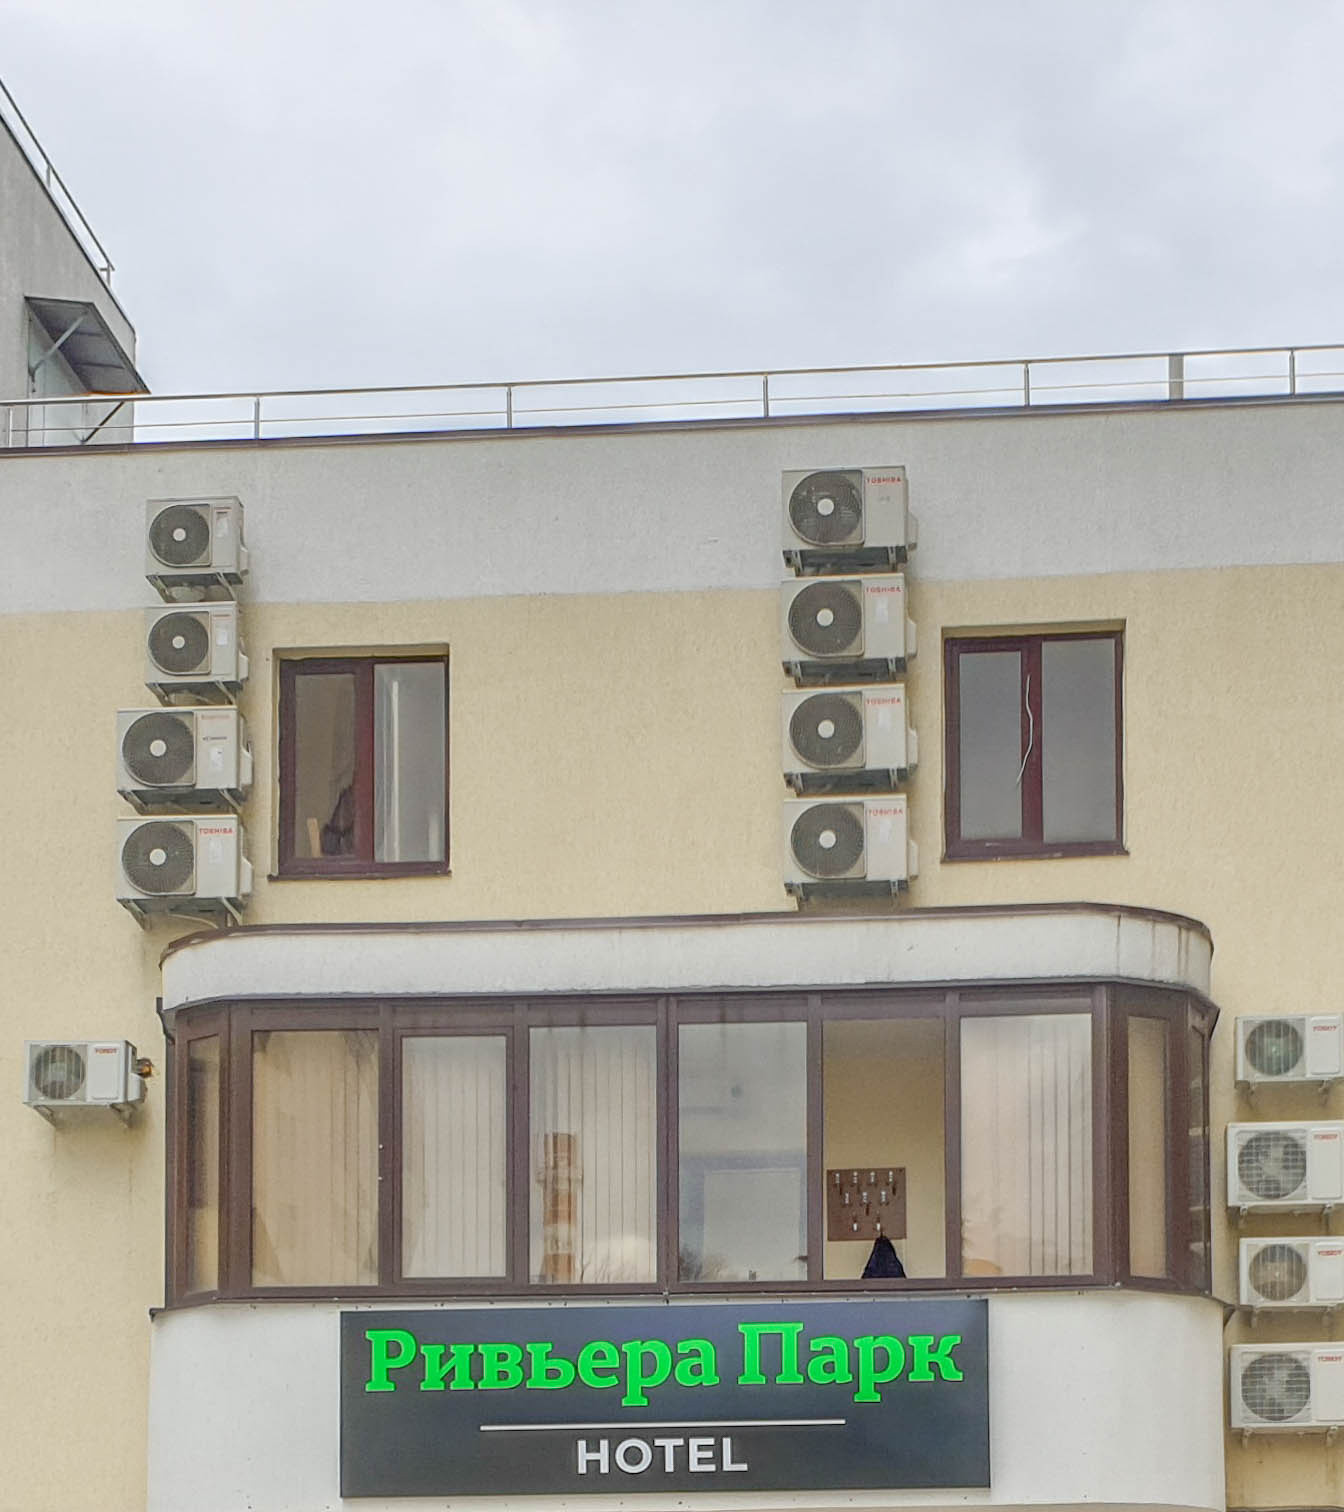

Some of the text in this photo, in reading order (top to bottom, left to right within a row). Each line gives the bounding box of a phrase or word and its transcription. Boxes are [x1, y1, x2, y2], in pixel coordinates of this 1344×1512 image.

[365, 1320, 964, 1407] Ривьера Парк
[576, 1436, 749, 1475] HOTEL
